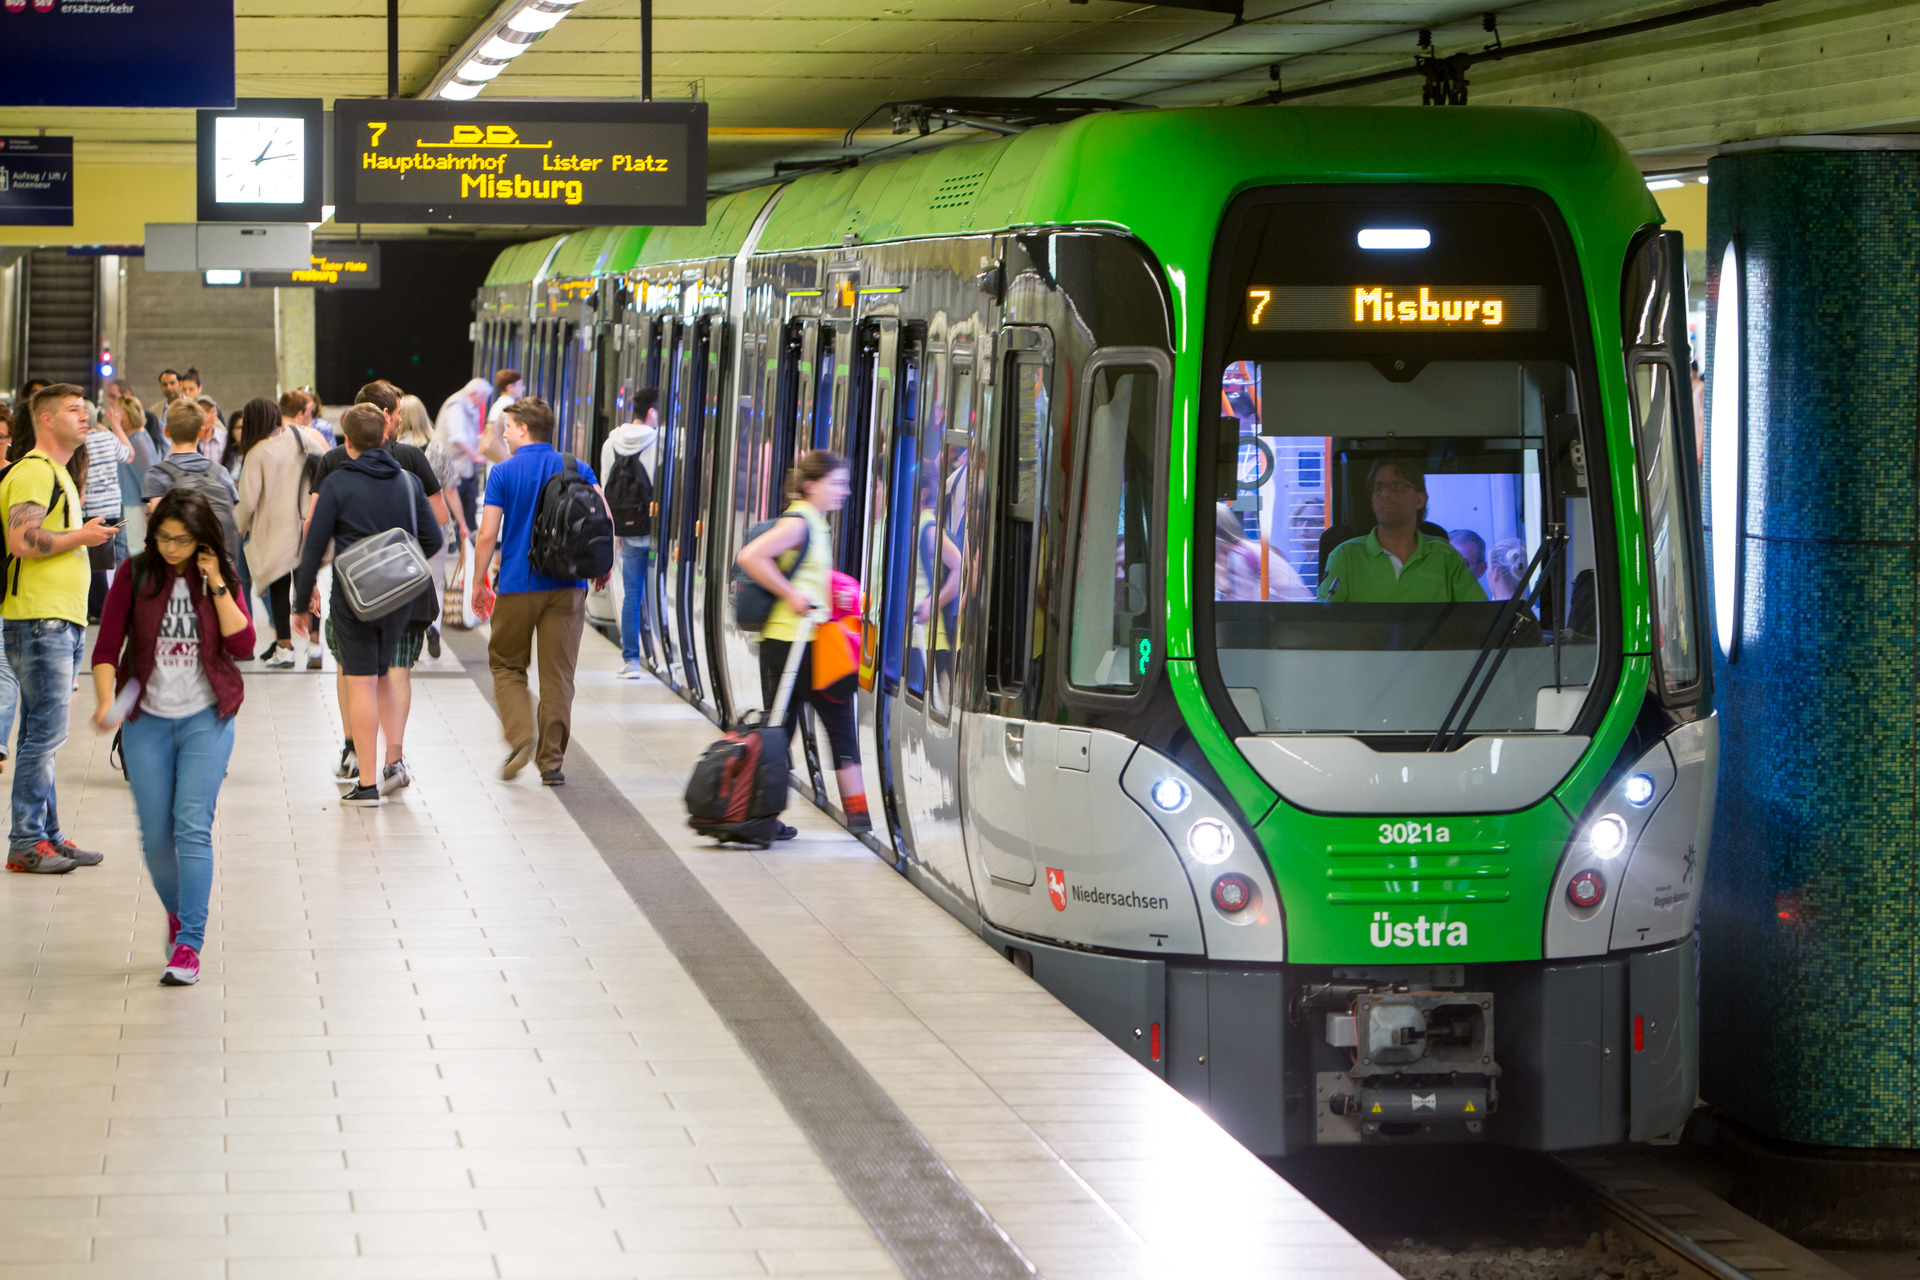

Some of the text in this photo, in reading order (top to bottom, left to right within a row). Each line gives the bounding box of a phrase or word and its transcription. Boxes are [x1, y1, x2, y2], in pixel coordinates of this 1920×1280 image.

[61, 3, 134, 14] ersatzverkehr
[368, 122, 387, 147] 7
[363, 152, 668, 175] Hauptbahnhof Lister Platz
[461, 173, 583, 206] Misburg
[1250, 286, 1504, 327] 7 Misburg
[1378, 823, 1450, 844] 3021a
[1072, 885, 1169, 909] Niedersachsen
[1370, 912, 1468, 948] üstra
